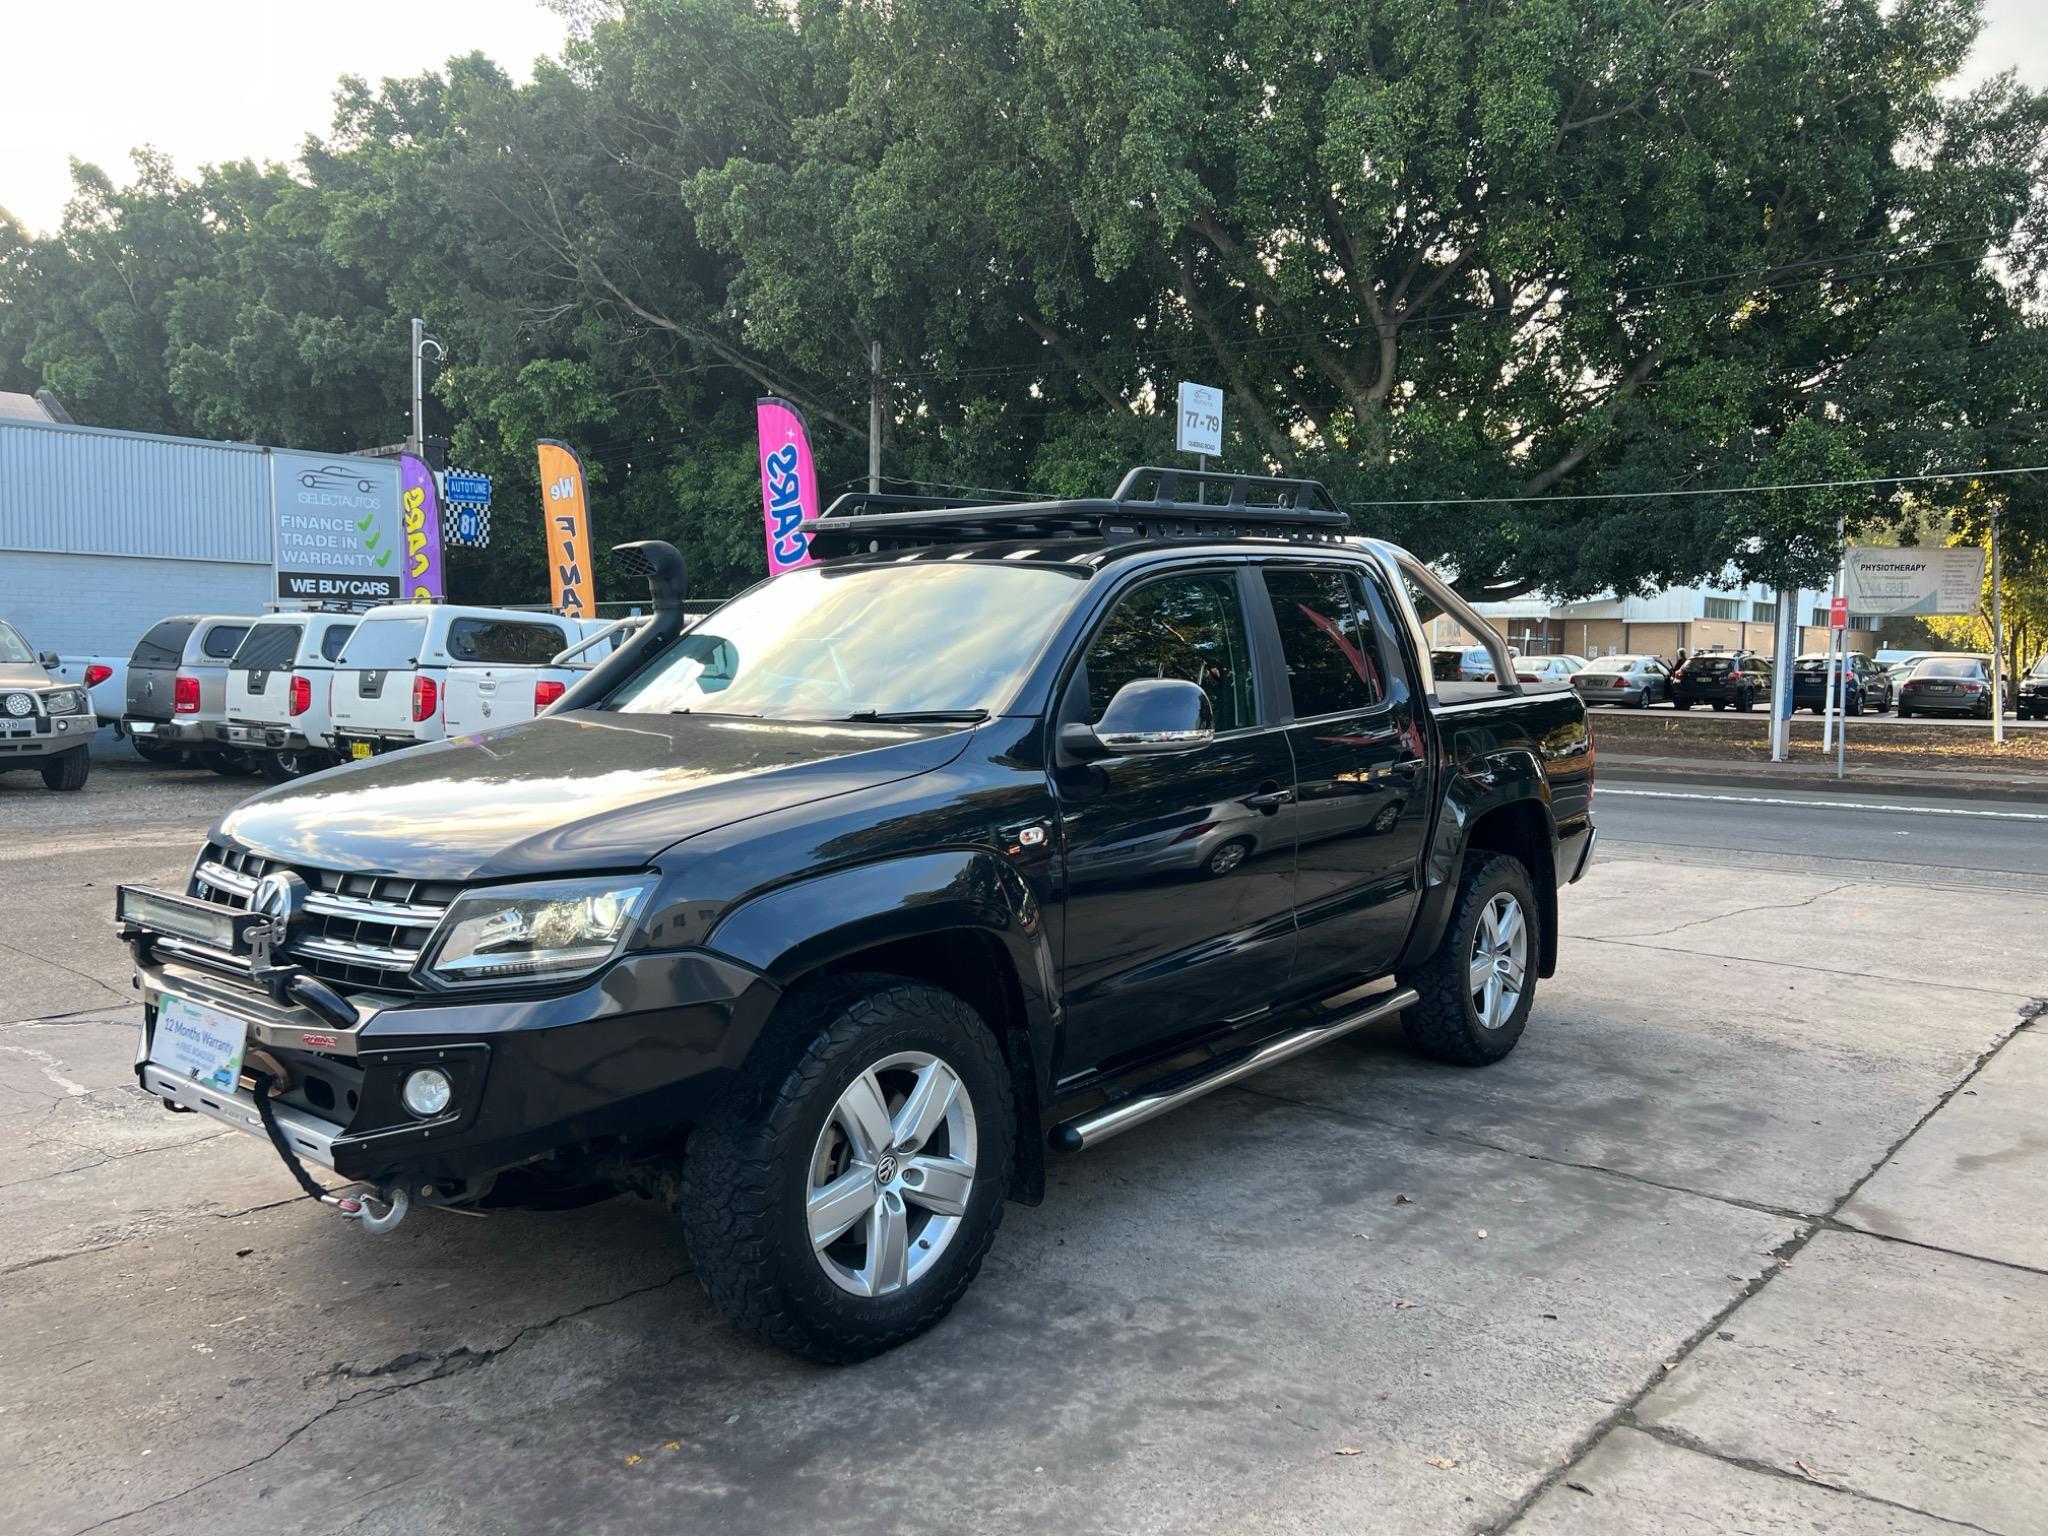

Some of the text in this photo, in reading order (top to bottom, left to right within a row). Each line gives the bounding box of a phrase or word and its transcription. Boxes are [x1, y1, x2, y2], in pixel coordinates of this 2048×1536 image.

[451, 480, 488, 494] AUTOTUNE
[280, 514, 354, 532] FINANCE
[461, 514, 476, 536] 81
[281, 532, 358, 549] TRADE IN
[281, 550, 376, 567] WARRANTY
[1860, 564, 1927, 572] PHYSIOTHERAPY
[290, 578, 390, 596] WE BUY CARS
[164, 1017, 174, 1032] 12
[174, 1019, 201, 1043] Months
[201, 1030, 235, 1057] Warranty
